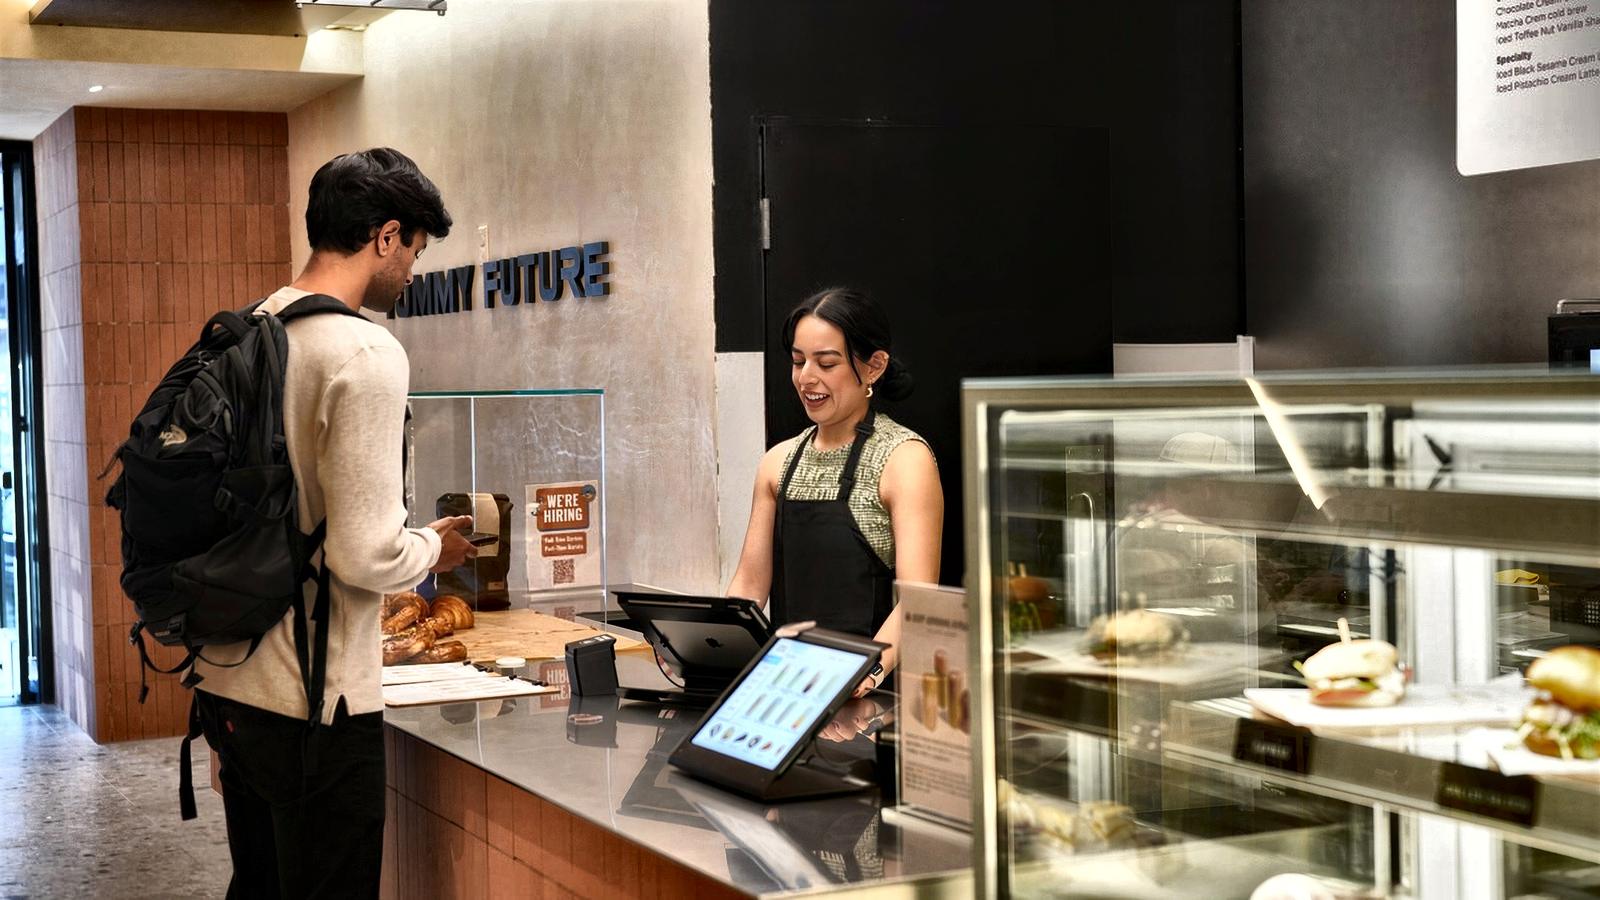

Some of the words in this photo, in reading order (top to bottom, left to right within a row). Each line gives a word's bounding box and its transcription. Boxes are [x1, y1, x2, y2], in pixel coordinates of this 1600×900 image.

[1496, 1, 1534, 16] Chocolate
[1496, 18, 1524, 30] Matcha
[1547, 8, 1565, 19] cold
[1567, 5, 1588, 15] brew
[1514, 29, 1539, 40] Toffee
[1540, 25, 1555, 35] Nut
[1557, 20, 1584, 32] Vanilla
[1496, 51, 1533, 66] Specialty
[1496, 69, 1513, 79] Iced
[1514, 65, 1536, 76] Black
[1536, 60, 1567, 72] Sesame
[1568, 54, 1596, 66] Cream
[1496, 82, 1513, 93] Iced
[1514, 78, 1550, 90] Pistachio
[1550, 72, 1577, 84] Cream
[387, 265, 475, 319] UMMY
[483, 241, 610, 309] FUTURE
[547, 494, 579, 508] WE'RE
[543, 508, 583, 523] HIRING
